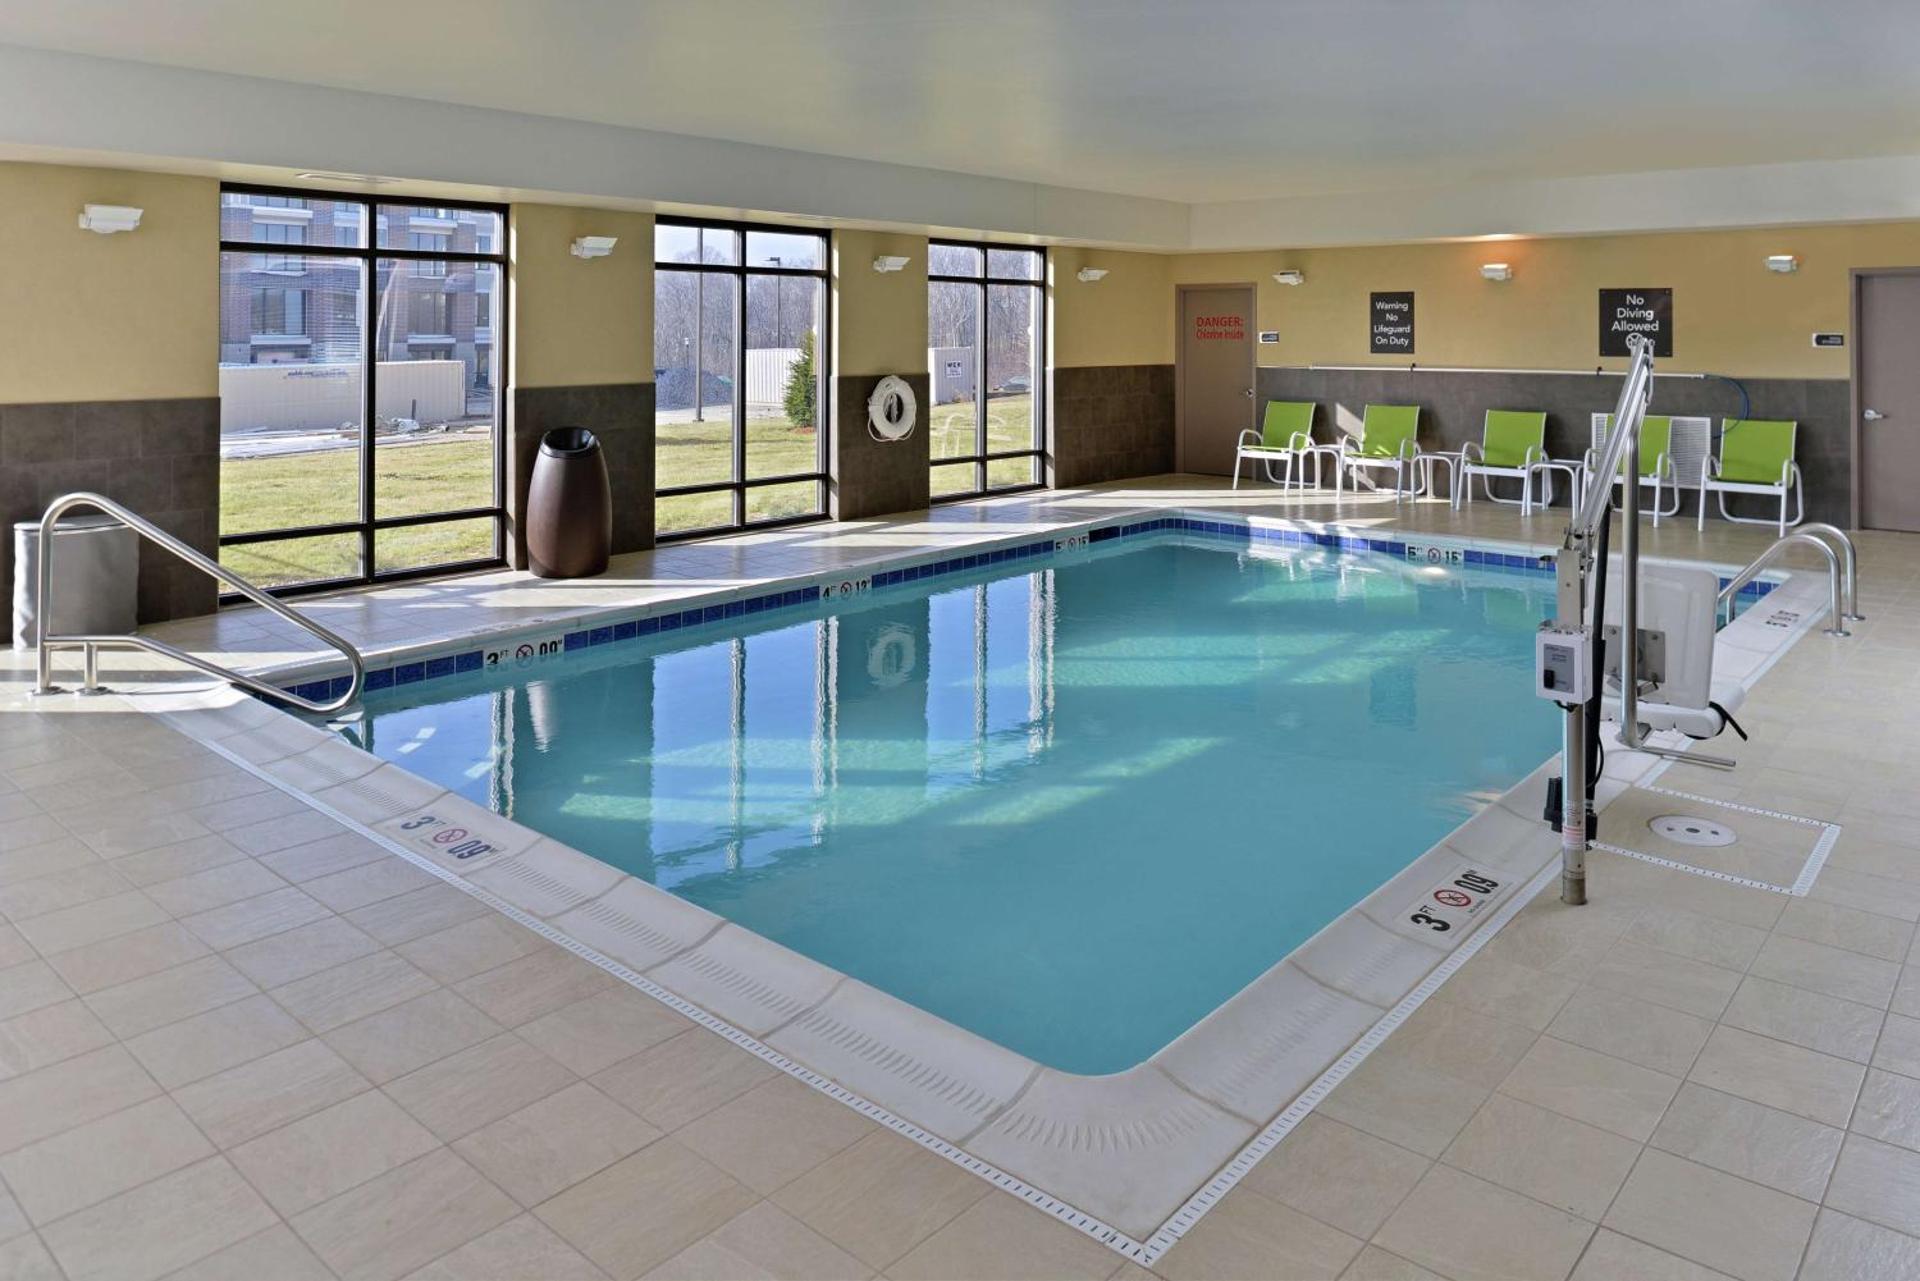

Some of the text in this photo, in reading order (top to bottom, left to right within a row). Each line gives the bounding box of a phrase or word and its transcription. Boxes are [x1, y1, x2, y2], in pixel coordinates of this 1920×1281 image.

[1626, 294, 1645, 306] No
[1376, 301, 1409, 312] Warning
[1385, 313, 1399, 322] No
[1617, 307, 1655, 321] Diving
[1196, 316, 1244, 327] DANGER:
[1611, 320, 1660, 332] Allowed
[1374, 325, 1411, 335] Lifeguard
[1375, 336, 1409, 347] On Duty
